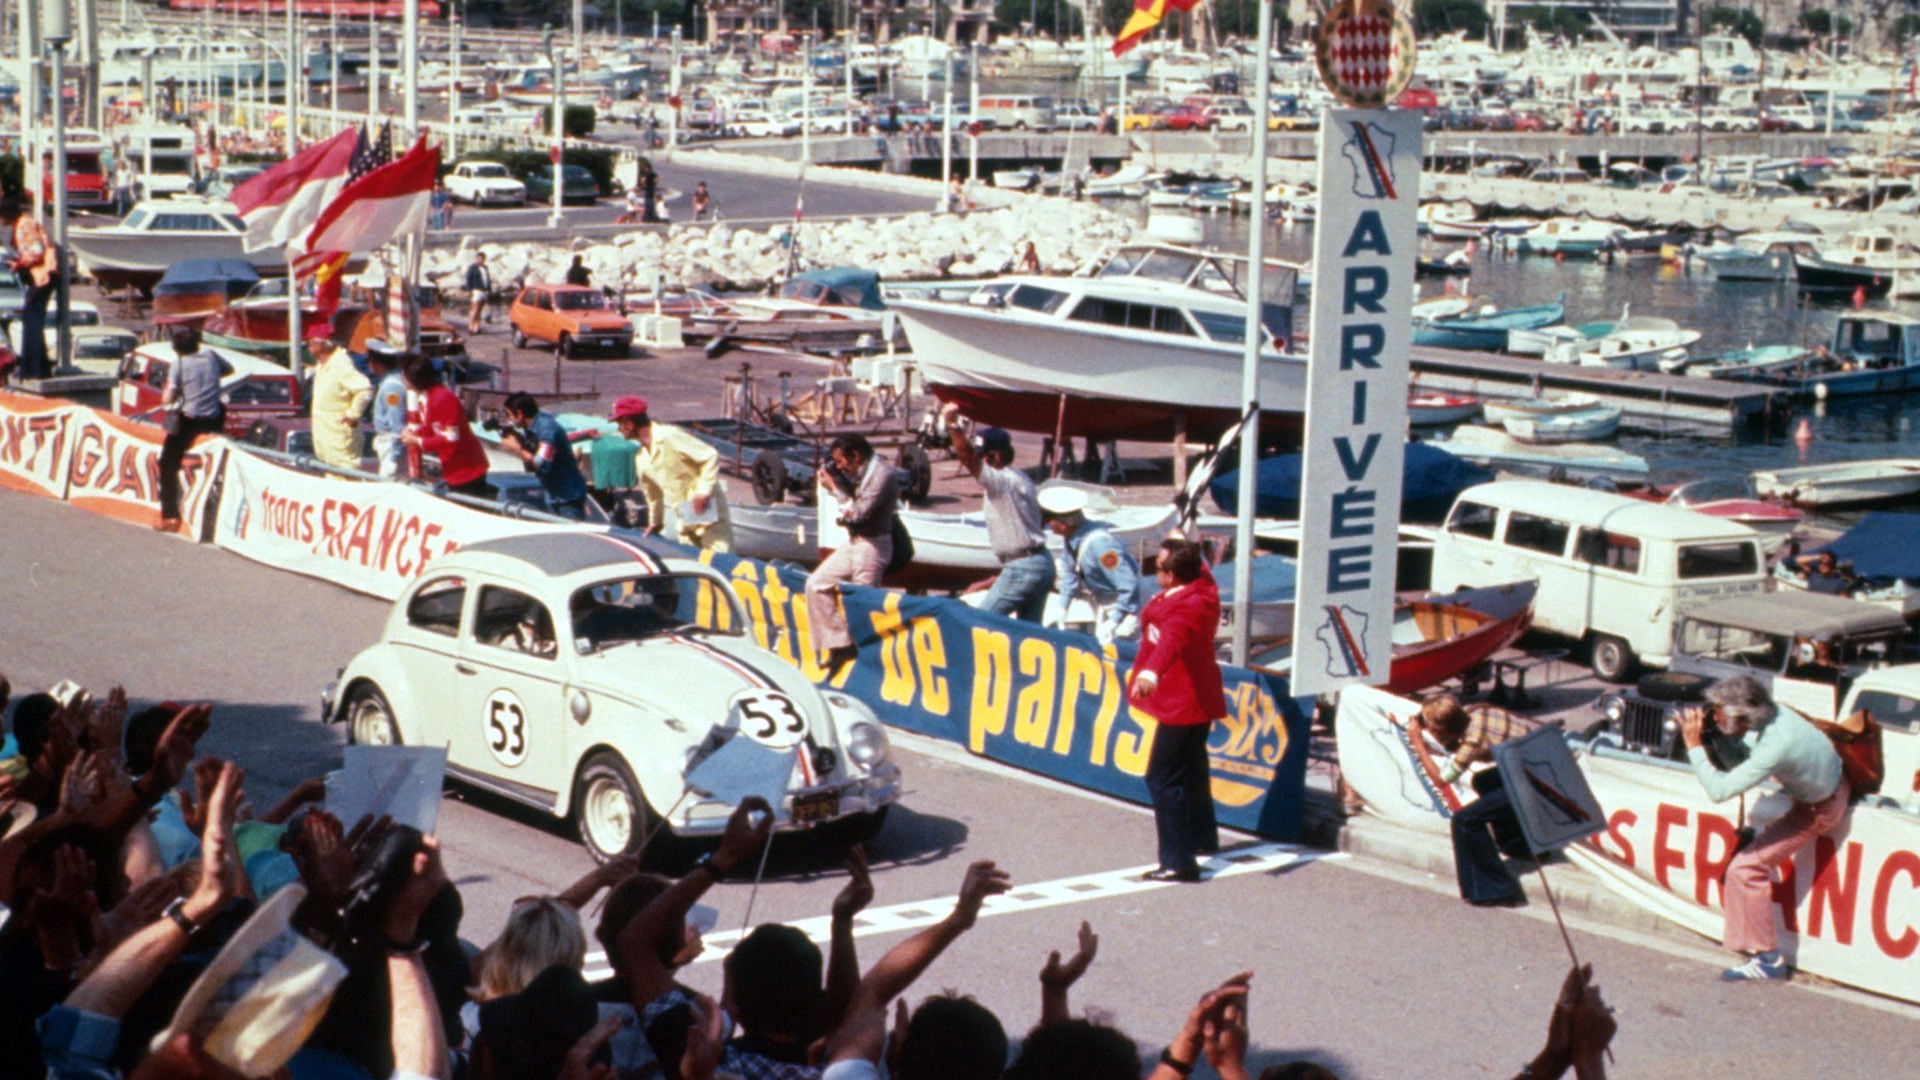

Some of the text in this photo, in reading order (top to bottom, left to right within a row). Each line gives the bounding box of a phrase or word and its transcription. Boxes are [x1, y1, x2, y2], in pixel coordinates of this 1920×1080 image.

[1326, 209, 1392, 594] ARRIVÉE
[0, 412, 73, 482] NTI
[738, 694, 804, 739] 53
[869, 592, 950, 717] de
[969, 626, 1160, 777] paris
[490, 700, 524, 756] 53
